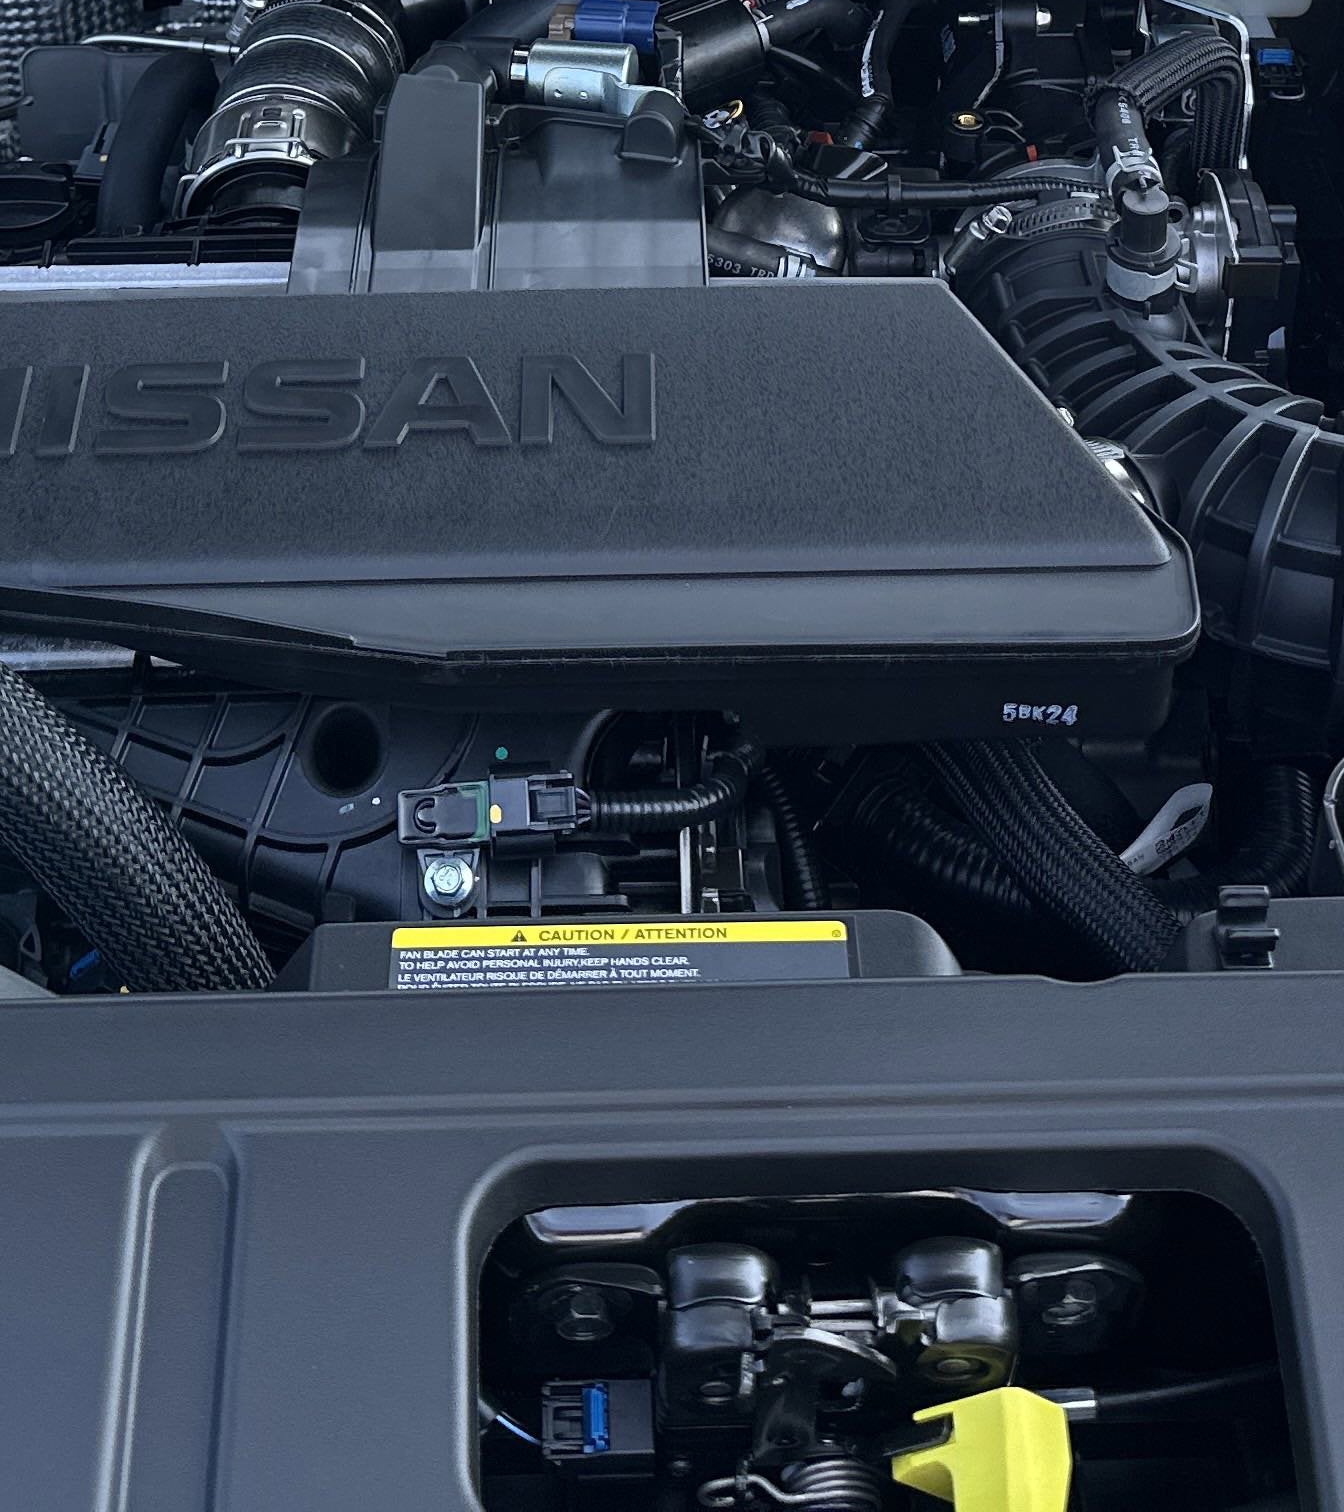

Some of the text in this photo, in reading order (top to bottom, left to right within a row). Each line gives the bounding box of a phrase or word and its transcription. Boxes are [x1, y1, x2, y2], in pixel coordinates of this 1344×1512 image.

[1002, 702, 1078, 726] 5BK24
[538, 927, 728, 941] CAUTION / ATTENTION
[399, 947, 590, 959] FAN BLADE CAN START AT ANY TIME.
[399, 961, 415, 970] TO
[416, 961, 445, 970] HELP
[447, 960, 480, 969] AVOID
[483, 959, 541, 969] PERSONAL
[611, 957, 649, 966] HANDS
[651, 956, 690, 965] CLEAR.
[398, 973, 411, 982] LE
[414, 972, 484, 982] VENTILATEUR
[486, 971, 528, 981] RISQUE
[530, 971, 545, 980] DE
[547, 968, 607, 980] DÉMARRER
[620, 969, 649, 978] TOUT
[650, 968, 701, 978] MOMENT.
